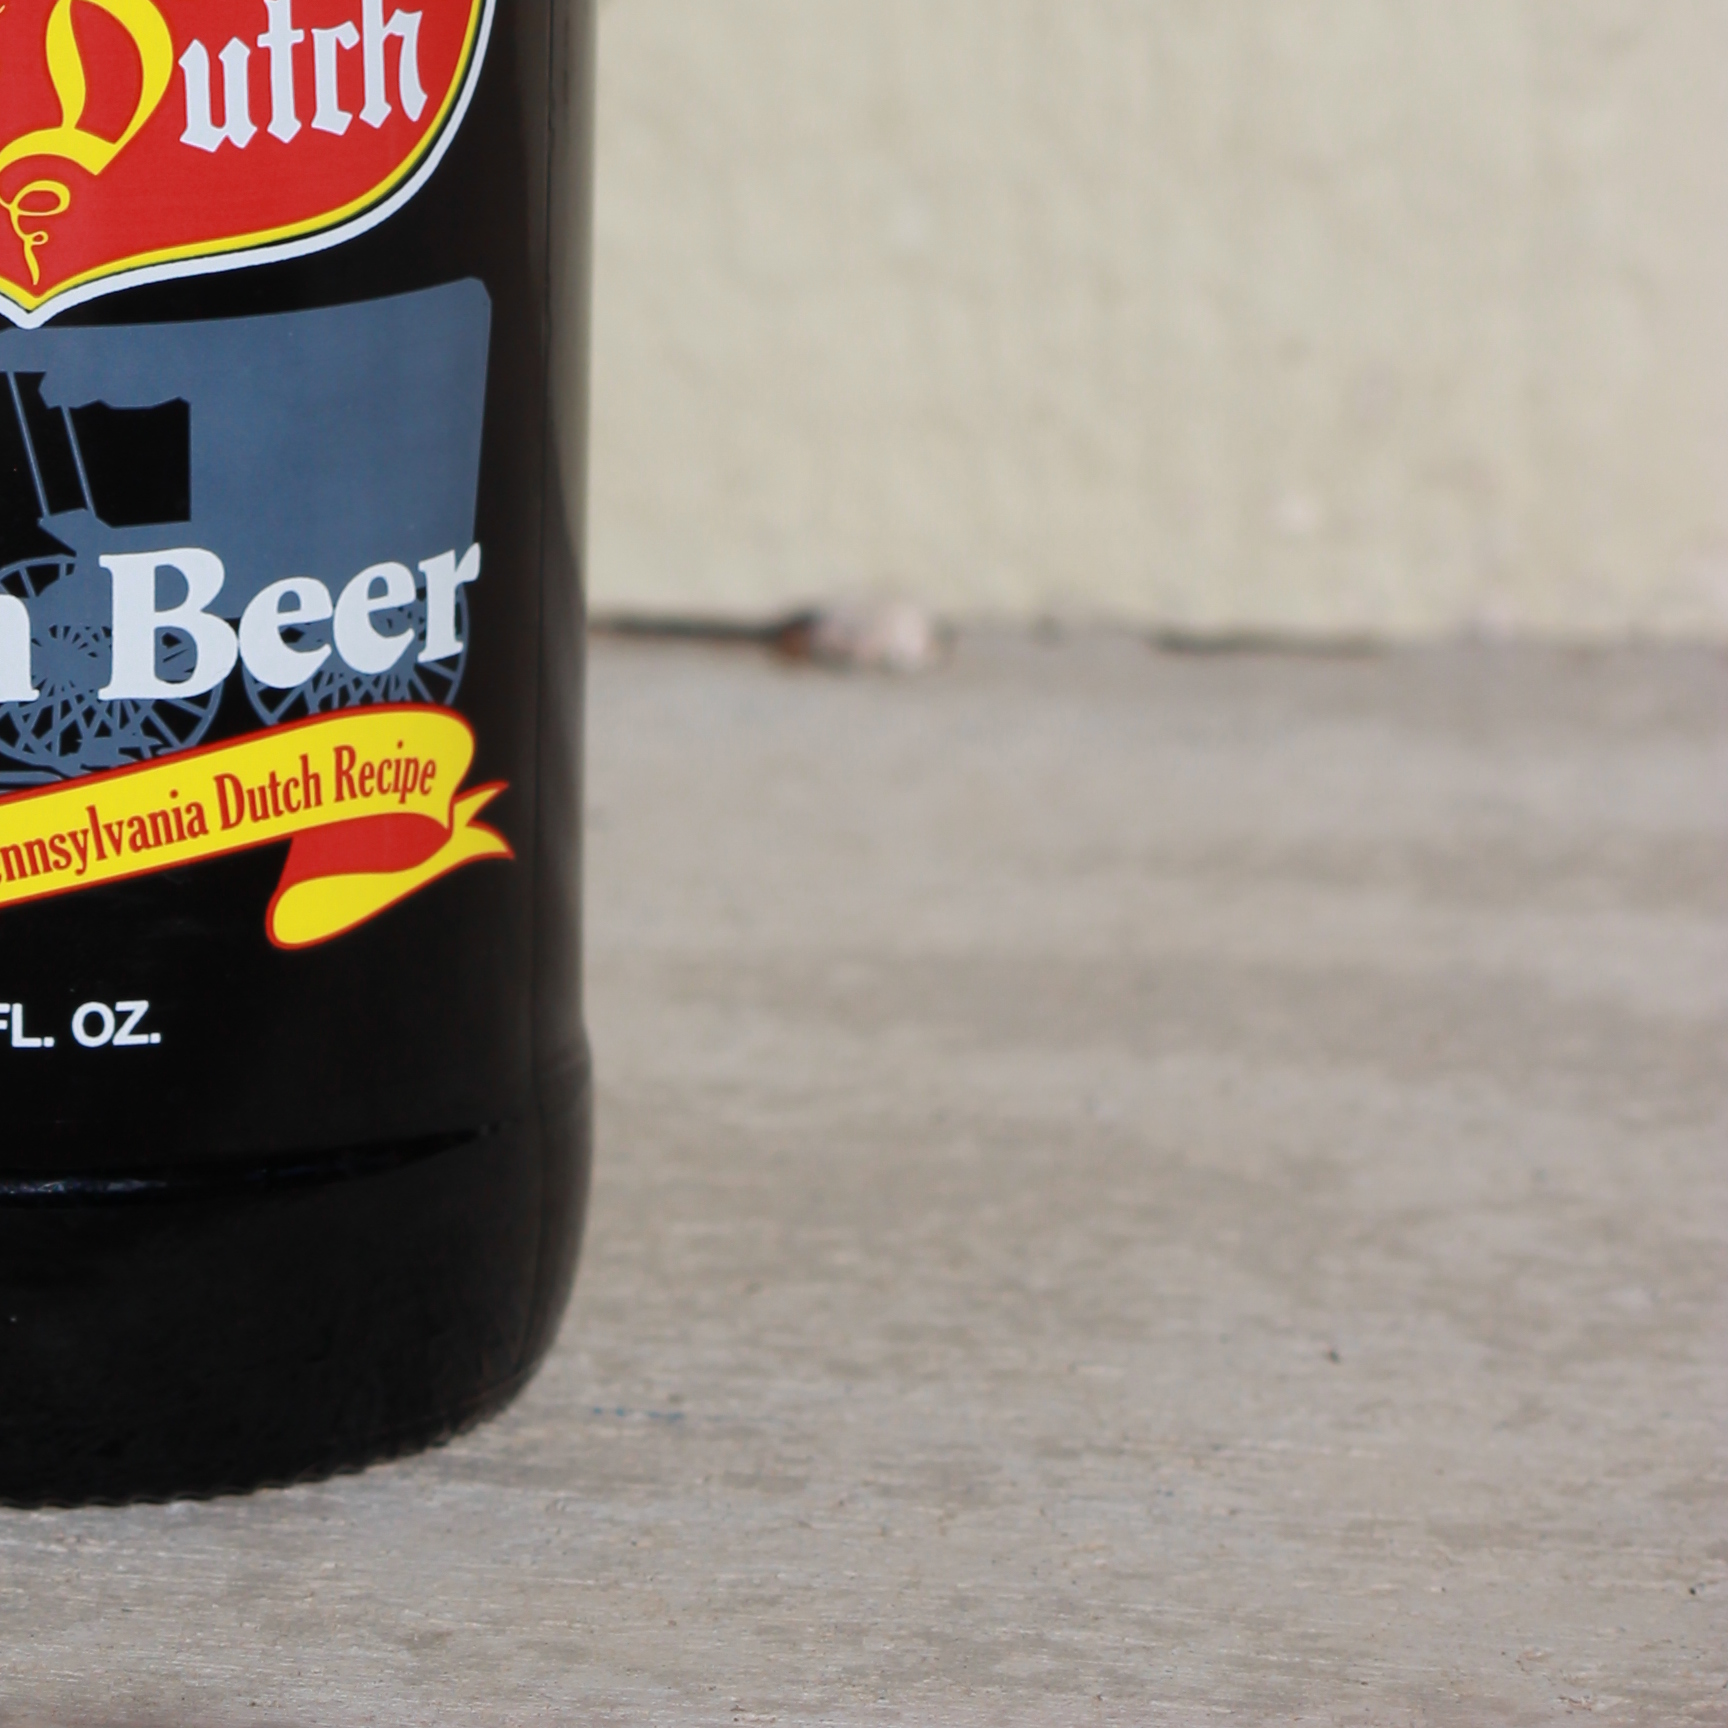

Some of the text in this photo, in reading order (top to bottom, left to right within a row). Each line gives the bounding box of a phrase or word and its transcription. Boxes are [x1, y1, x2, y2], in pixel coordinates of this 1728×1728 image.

[98, 541, 482, 703] Beer
[213, 754, 323, 832] Dutch
[332, 740, 437, 804] Recipe
[71, 1000, 162, 1047] OZ.
